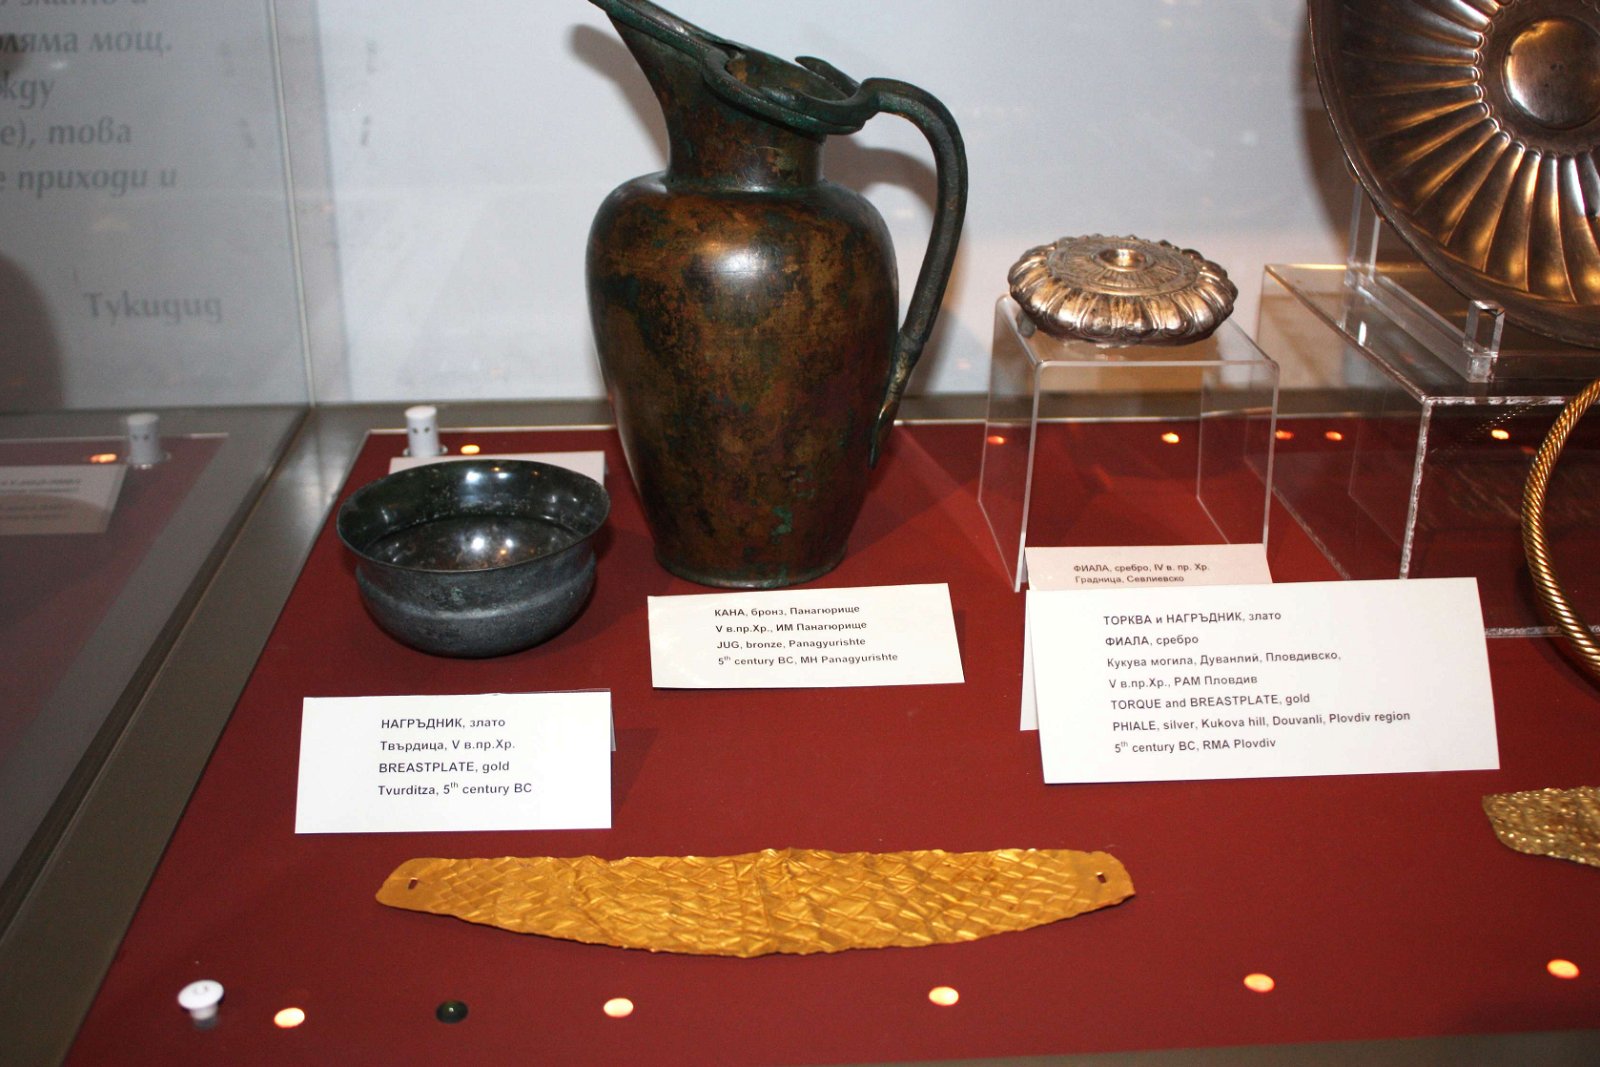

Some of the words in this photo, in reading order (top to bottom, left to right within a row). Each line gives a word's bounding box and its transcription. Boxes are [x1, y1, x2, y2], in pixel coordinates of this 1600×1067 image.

[0, 31, 78, 53] ляма
[89, 31, 172, 57] мощ.
[18, 169, 148, 198] приходи
[160, 169, 178, 187] и
[84, 293, 222, 323] Тукидид
[1073, 564, 1112, 573] ФИАЛА,
[1115, 564, 1152, 573] сребро,
[1153, 563, 1164, 572] IV
[1166, 564, 1175, 572] в.
[1177, 564, 1192, 573] пр.
[1194, 563, 1209, 573] Хр.
[1074, 575, 1125, 585] Градница,
[1126, 574, 1185, 583] Севлиевско
[715, 608, 749, 617] КАНА,
[751, 607, 787, 618] бронз,
[790, 606, 860, 616] Панагюрище
[1104, 614, 1153, 626] ТОРКВА
[1156, 616, 1163, 624] и
[1167, 611, 1246, 624] НАГРЪДНИК,
[1249, 612, 1282, 622] злато
[716, 624, 723, 633] V
[726, 624, 773, 635] в.пр.Хр.,
[776, 623, 794, 632] ИМ
[797, 622, 868, 632] Панагюрище
[717, 640, 743, 650] JUG,
[746, 640, 786, 649] bronze,
[789, 637, 866, 650] Panagyurishte
[1106, 635, 1153, 647] ФИАЛА,
[1156, 634, 1199, 647] сребро
[719, 655, 731, 666] 5th
[735, 657, 775, 667] century
[778, 655, 798, 665] BC,
[801, 655, 818, 664] MH
[822, 652, 898, 665] Panagyurishte
[1107, 657, 1147, 670] Кукува
[1151, 657, 1197, 666] могила,
[1200, 653, 1263, 667] Дуванлий,
[1266, 652, 1341, 663] Пловдивско,
[1109, 679, 1117, 689] V
[1121, 677, 1171, 690] в.пр.Хр.,
[1174, 675, 1201, 687] РАМ
[1205, 675, 1258, 686] Пловдив
[1111, 698, 1162, 710] TORQUE
[1166, 697, 1187, 709] and
[1190, 694, 1283, 708] BREASTPLATE,
[1286, 693, 1311, 707] gold
[382, 717, 466, 731] НАГРЪДНИК,
[470, 719, 506, 728] злато
[1113, 720, 1160, 732] PHIALE,
[1163, 719, 1198, 730] silver,
[1202, 718, 1245, 729] Kukova
[1249, 716, 1269, 727] hill,
[1273, 714, 1326, 726] Douvanli,
[1329, 712, 1371, 724] Plovdiv
[1375, 711, 1411, 724] region
[380, 740, 448, 753] Твърдица,
[452, 739, 461, 750] V
[463, 738, 516, 752] в.пр.Хр.
[1115, 741, 1129, 754] 5th
[1132, 743, 1175, 754] century
[1179, 740, 1200, 751] BC,
[1203, 739, 1231, 750] RMA
[1234, 737, 1276, 749] Plovdiv
[379, 761, 479, 774] BREASTPLATE,
[482, 760, 510, 775] gold
[378, 784, 439, 796] Tvurditza,
[443, 781, 459, 795] 5th
[462, 784, 510, 797] century
[515, 782, 532, 794] BC
